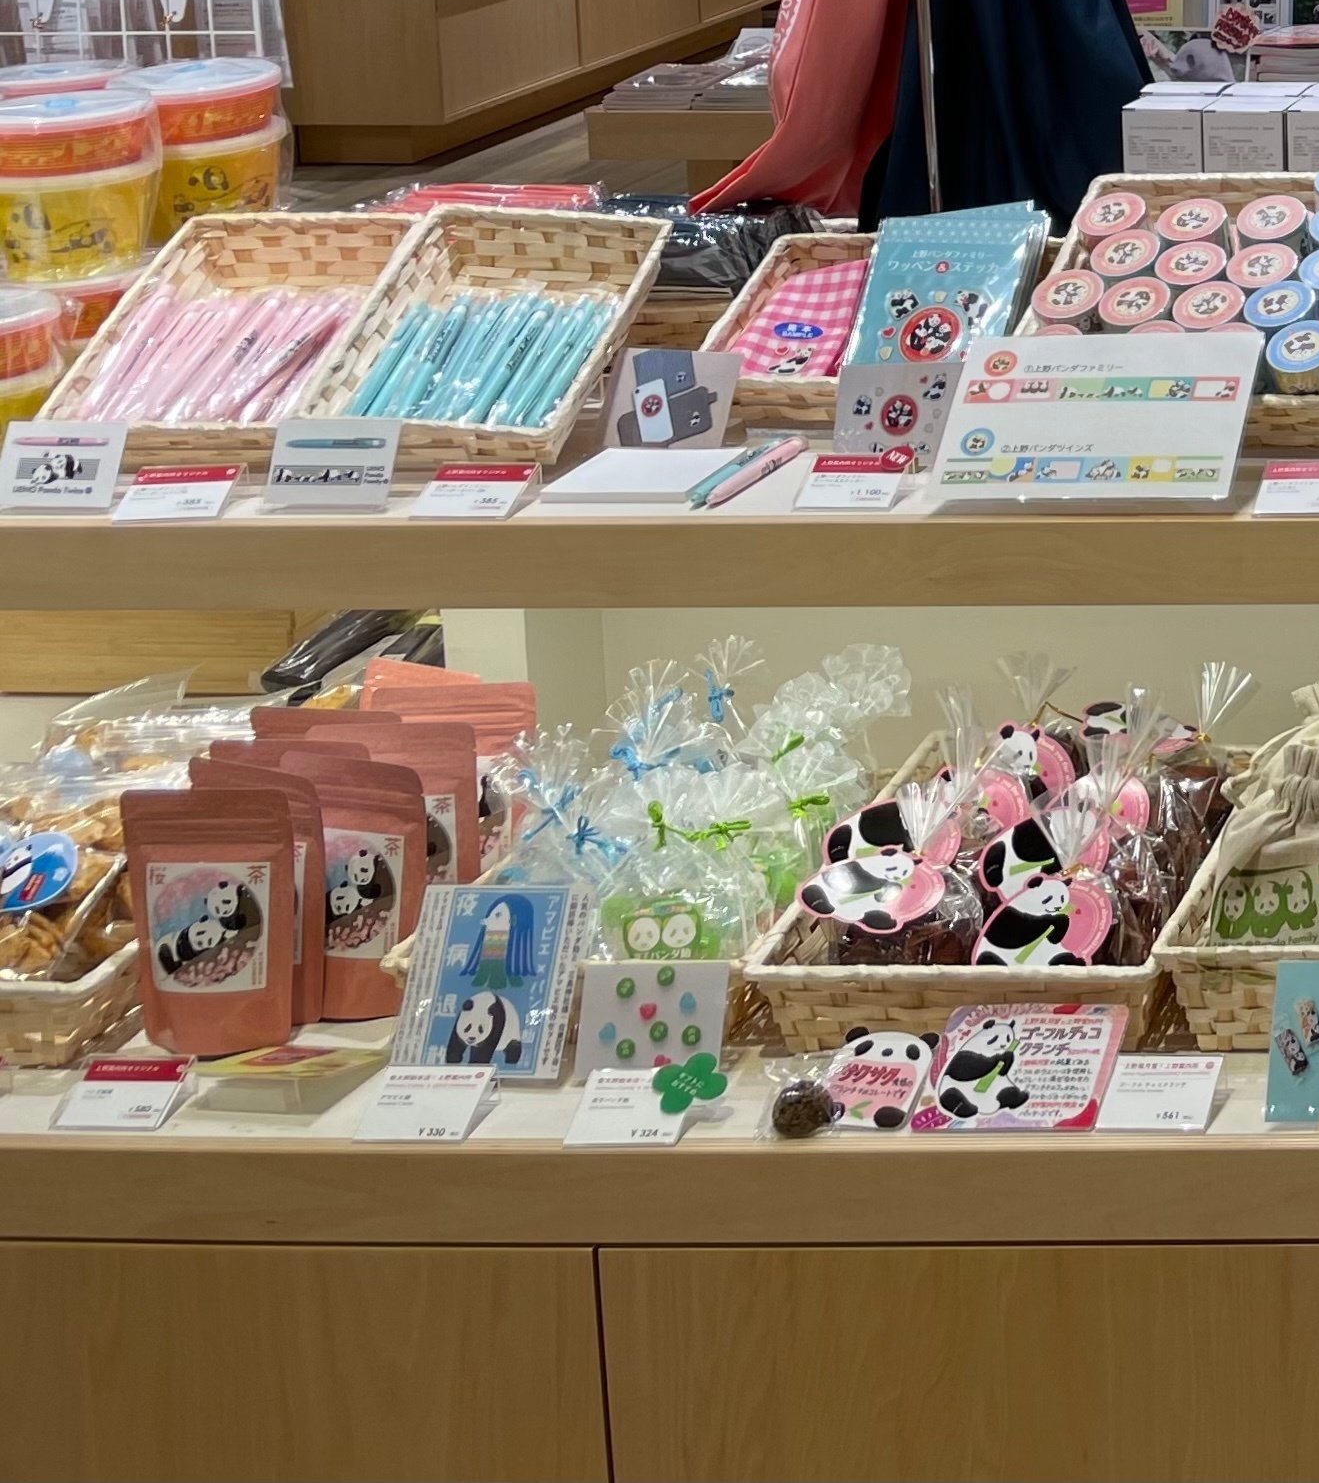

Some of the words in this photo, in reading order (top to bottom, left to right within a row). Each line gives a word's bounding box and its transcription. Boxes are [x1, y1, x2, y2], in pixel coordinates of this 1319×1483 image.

[886, 450, 909, 465] NEW
[38, 486, 62, 494] Panda
[248, 864, 267, 884] 茶
[1019, 1026, 1103, 1041] ゴーフルチョコ
[1018, 1042, 1072, 1057] クランチ
[838, 1062, 902, 1086] サクサク
[1157, 1111, 1180, 1120] ¥561
[418, 1127, 446, 1137] ¥330
[631, 1128, 659, 1138] ¥324
